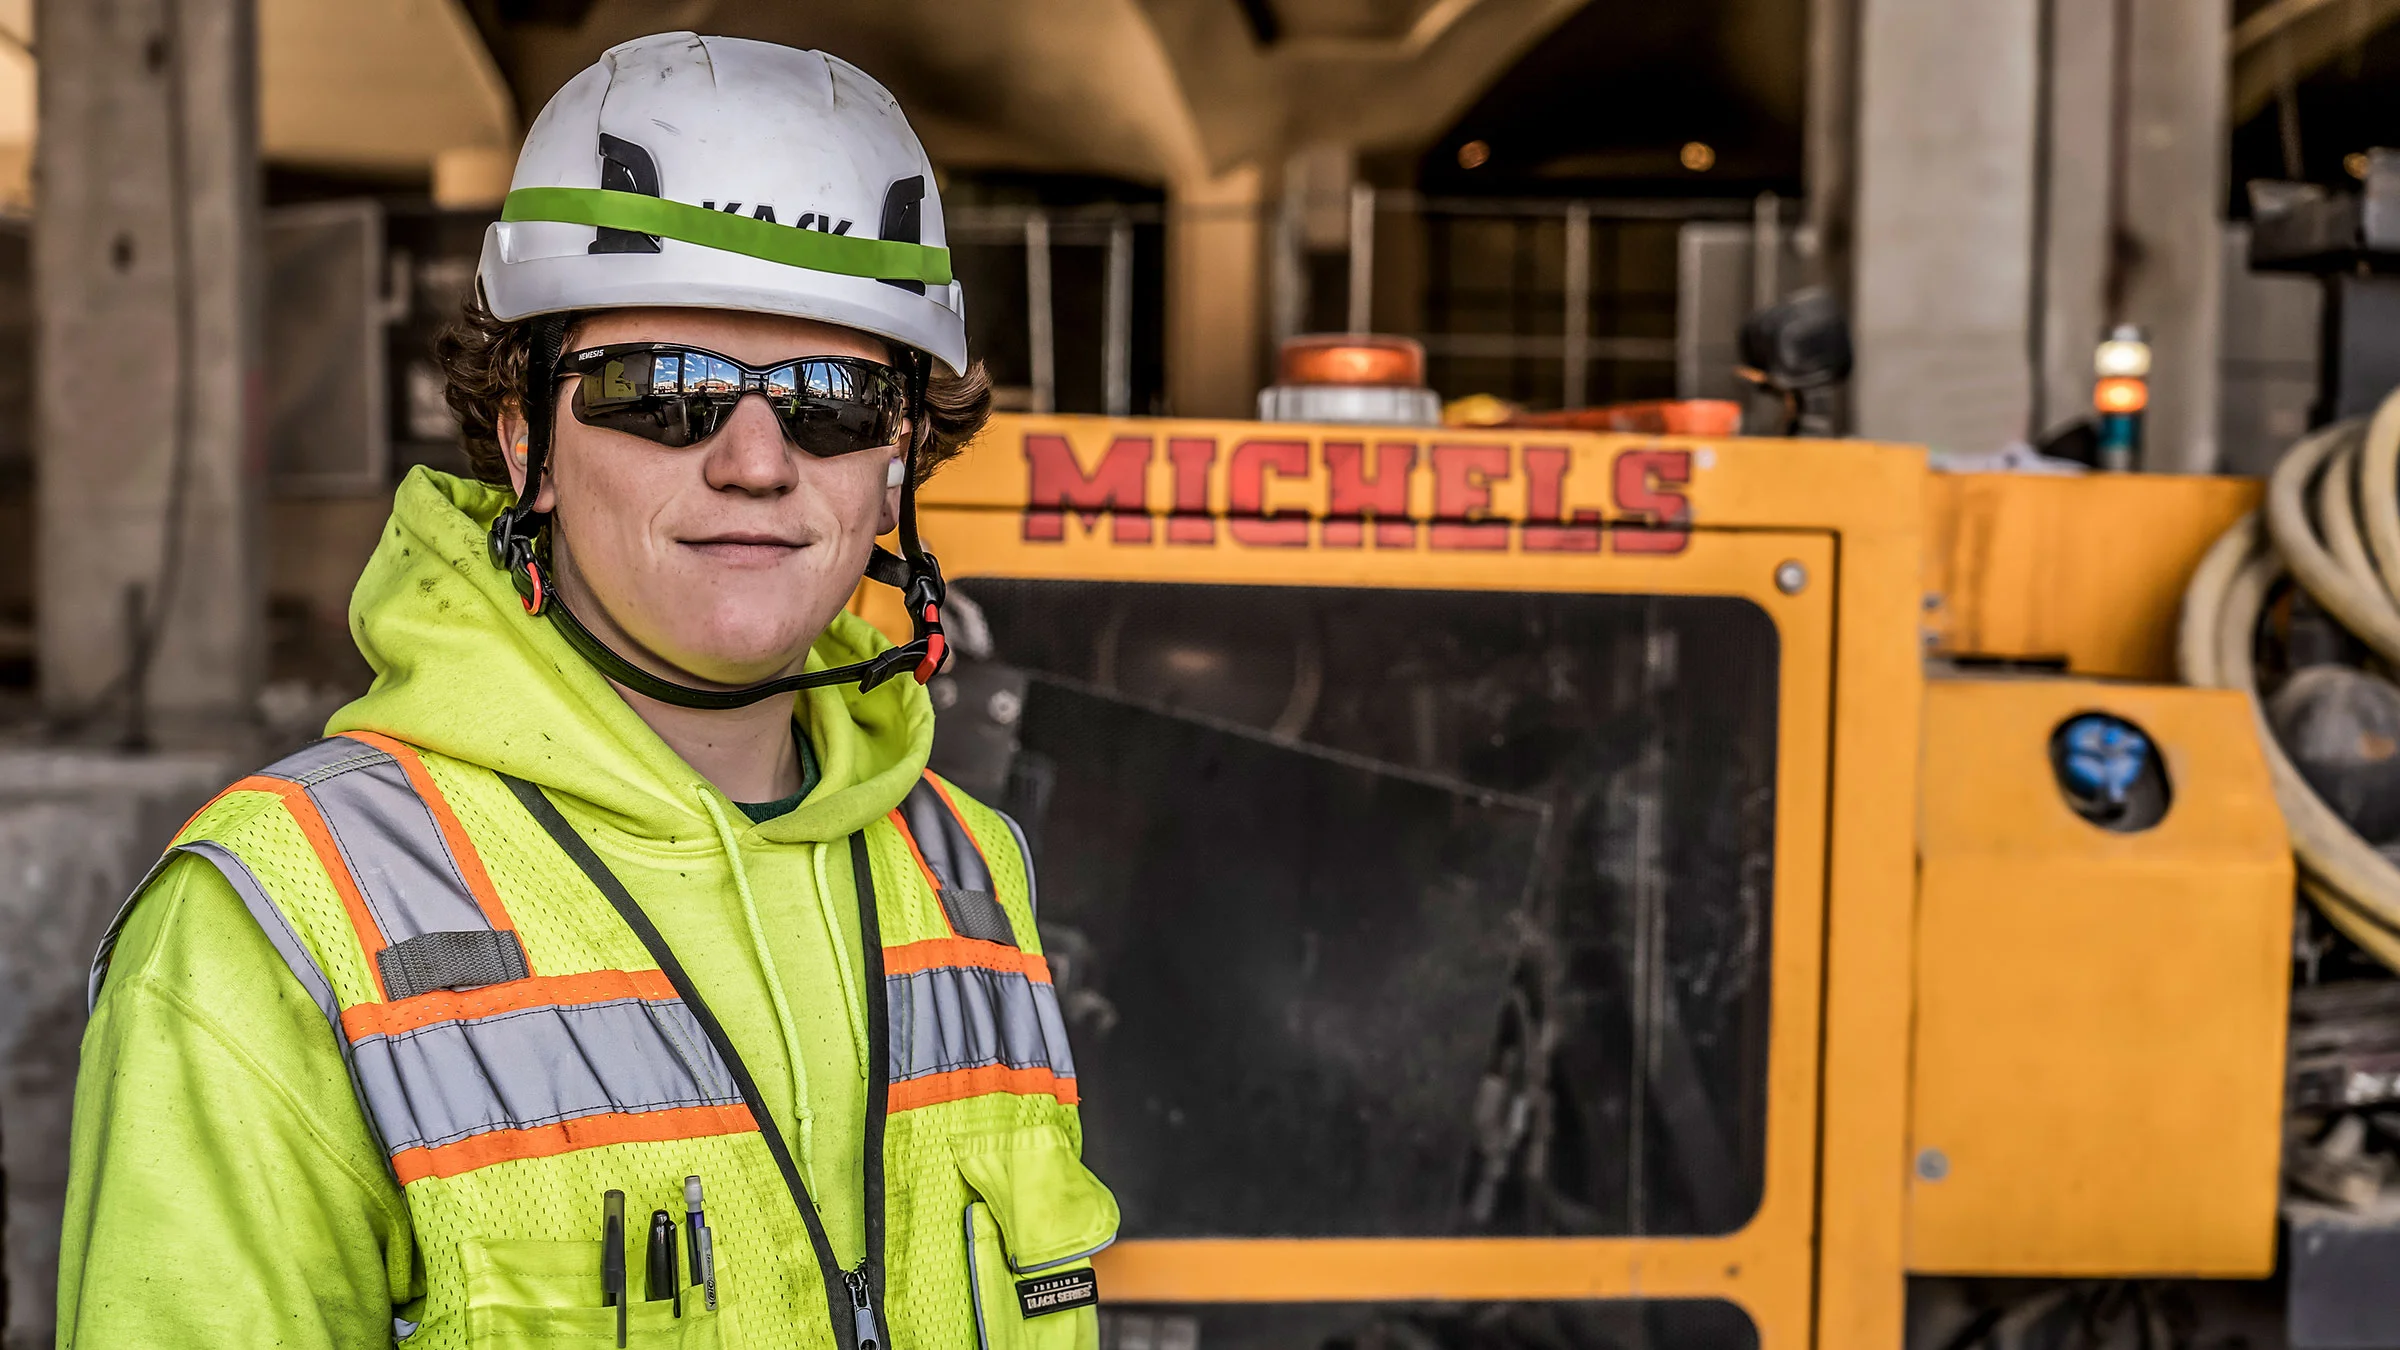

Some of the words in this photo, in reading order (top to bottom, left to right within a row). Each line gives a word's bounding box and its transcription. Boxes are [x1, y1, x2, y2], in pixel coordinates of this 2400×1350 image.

[578, 349, 604, 361] NEMESIS
[1022, 434, 1694, 554] MICHELS
[1033, 1277, 1079, 1292] PREMIUM
[1027, 1294, 1057, 1310] BLACK
